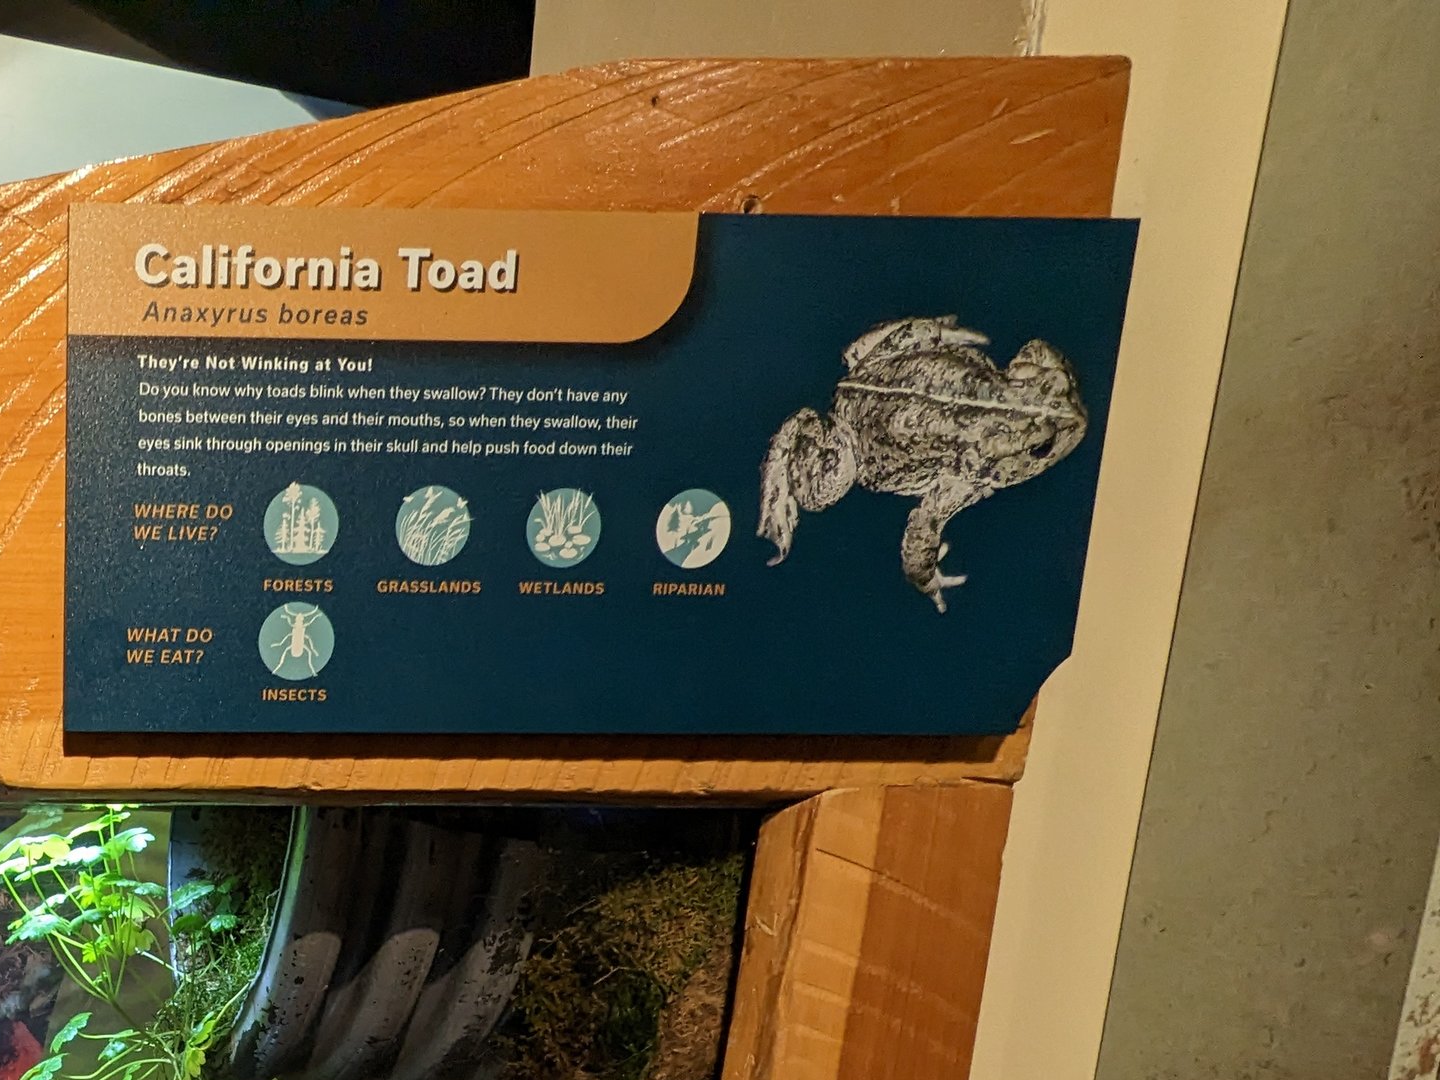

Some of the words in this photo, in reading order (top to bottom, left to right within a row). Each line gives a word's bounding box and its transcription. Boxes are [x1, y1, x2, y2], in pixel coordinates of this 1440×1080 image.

[134, 243, 382, 292] California
[398, 248, 520, 293] Toad
[142, 301, 268, 328] Anaxyrus
[278, 303, 369, 326] boreas
[137, 354, 199, 371] They're
[206, 356, 235, 370] Not
[241, 356, 309, 374] Winking
[315, 359, 331, 371] at
[338, 358, 373, 372] You!
[139, 382, 159, 396] Do
[163, 386, 188, 399] you
[193, 384, 230, 397] know
[234, 385, 263, 400] why
[266, 385, 306, 398] toads
[310, 385, 343, 398] blink
[348, 386, 385, 399] when
[390, 386, 420, 402] they
[423, 387, 485, 400] swallow?
[489, 387, 523, 403] They
[526, 388, 562, 401] don't
[567, 389, 599, 402] have
[603, 391, 628, 405] any
[139, 409, 182, 423] bones
[185, 410, 246, 424] between
[250, 411, 282, 424] their
[286, 415, 318, 427] eyes
[322, 412, 348, 425] and
[352, 412, 385, 426] their
[388, 414, 444, 429] mouths,
[448, 416, 465, 427] so
[469, 414, 506, 427] when
[510, 415, 541, 430] they
[544, 415, 601, 430] swallow,
[606, 416, 638, 429] their
[138, 440, 170, 451] eyes
[174, 437, 202, 450] sink
[206, 437, 261, 453] through
[266, 439, 331, 454] openings
[334, 438, 347, 452] in
[351, 439, 383, 452] their
[386, 439, 418, 453] skull
[422, 440, 448, 453] and
[452, 440, 482, 456] help
[485, 440, 519, 456] push
[523, 441, 555, 454] food
[559, 442, 597, 455] down
[601, 442, 633, 456] their
[137, 463, 190, 477] throats.
[134, 504, 199, 519] WHERE
[206, 505, 233, 519] DO
[134, 525, 162, 540] WE
[167, 526, 218, 541] LIVE?
[263, 579, 334, 592] FORESTS
[377, 580, 482, 594] GRASSLANDS
[519, 581, 605, 595] WETLANDS
[652, 583, 725, 596] RIPARIAN
[127, 628, 180, 643] WHAT
[186, 628, 213, 643] DO
[126, 649, 154, 664] WE
[160, 650, 204, 664] EAT?
[262, 689, 327, 701] INSECTS
